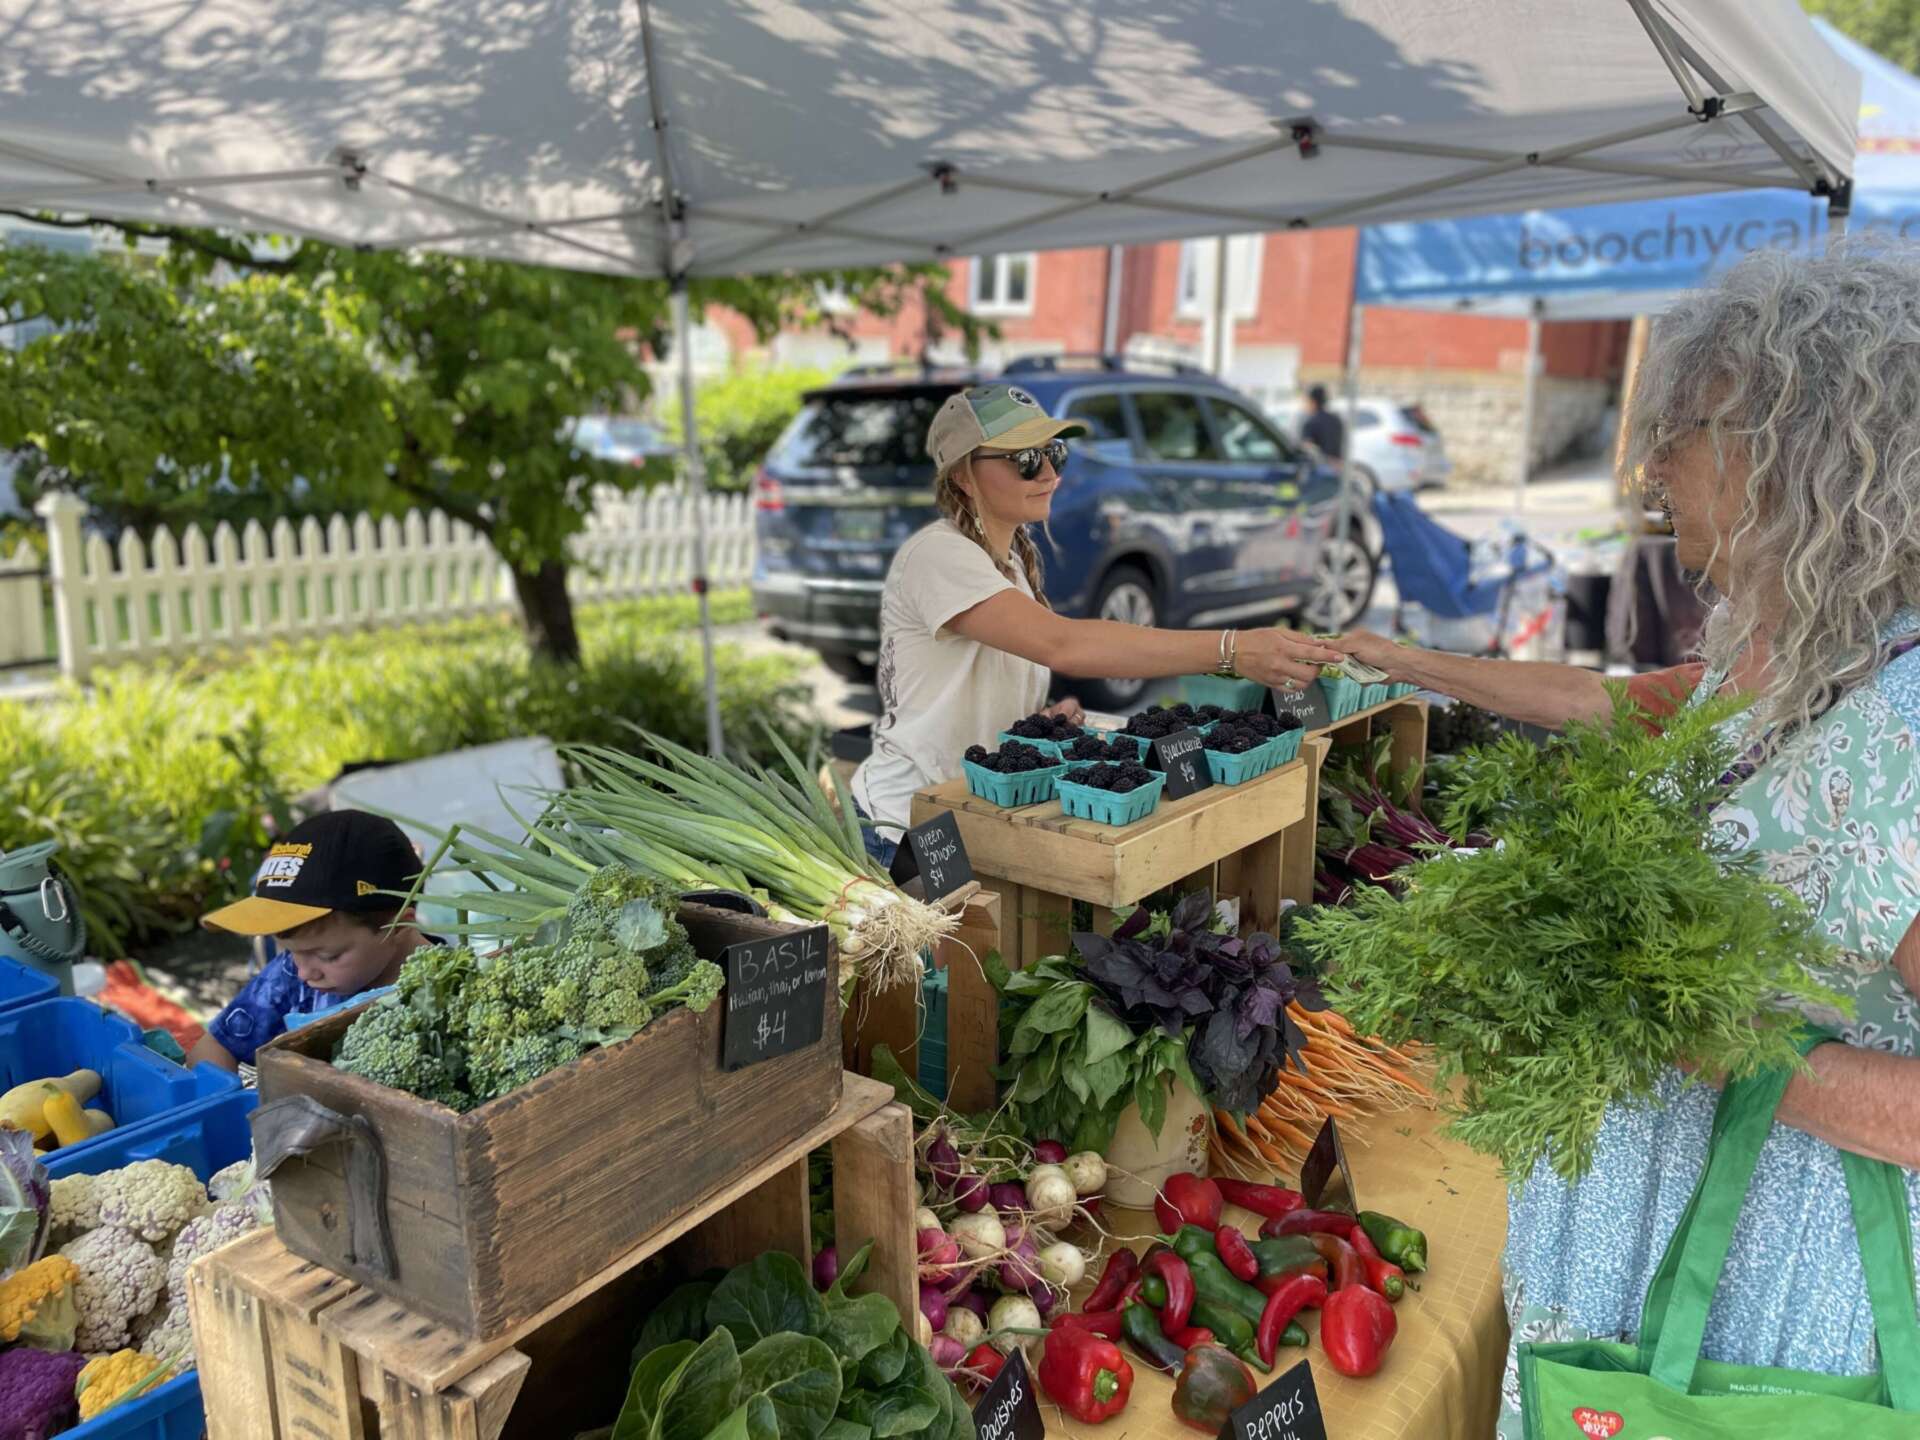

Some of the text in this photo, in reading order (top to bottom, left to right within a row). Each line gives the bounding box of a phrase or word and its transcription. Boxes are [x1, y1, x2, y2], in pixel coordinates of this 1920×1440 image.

[918, 828, 945, 856] green
[929, 839, 957, 865] onions
[930, 866, 945, 889] $4
[738, 934, 820, 984] BASIL
[792, 974, 803, 990] or
[804, 966, 827, 984] lemon
[752, 1009, 787, 1051] $4
[1729, 1383, 1759, 1393] MADE
[1762, 1384, 1792, 1396] FROM
[1246, 1388, 1304, 1440] Peppers
